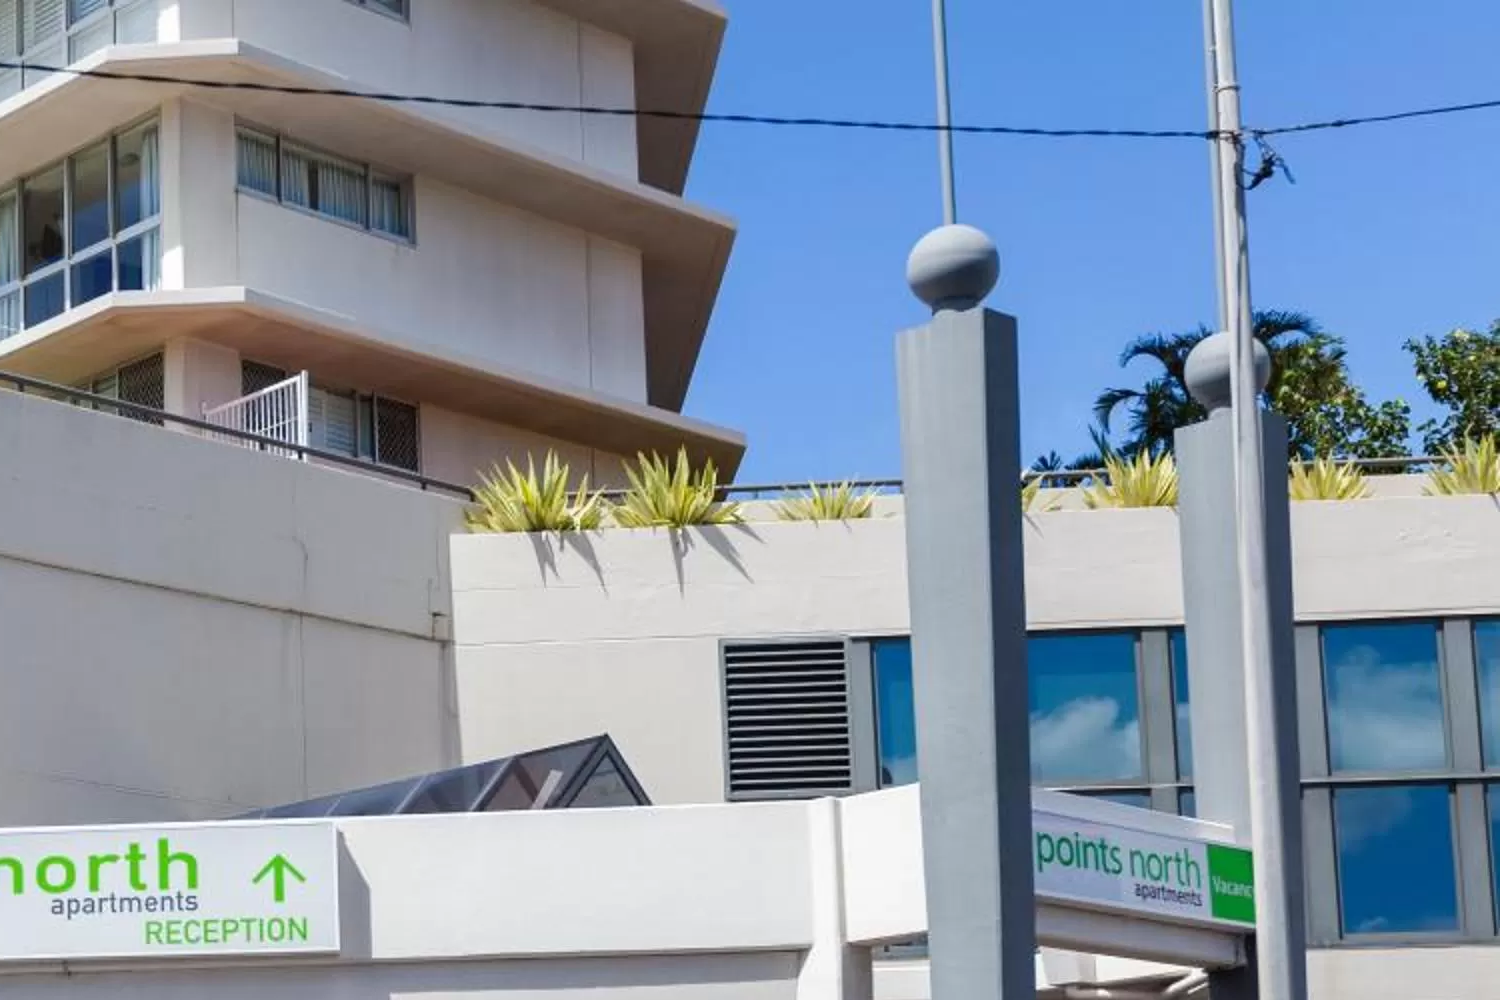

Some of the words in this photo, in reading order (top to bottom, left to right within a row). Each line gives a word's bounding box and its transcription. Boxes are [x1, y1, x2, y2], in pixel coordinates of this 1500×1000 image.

[1035, 831, 1123, 875] points
[1128, 848, 1202, 889] north
[1134, 882, 1204, 907] apartments
[1211, 875, 1253, 898] Vacanc
[50, 890, 199, 920] apartments
[144, 915, 309, 945] RECEPTION
